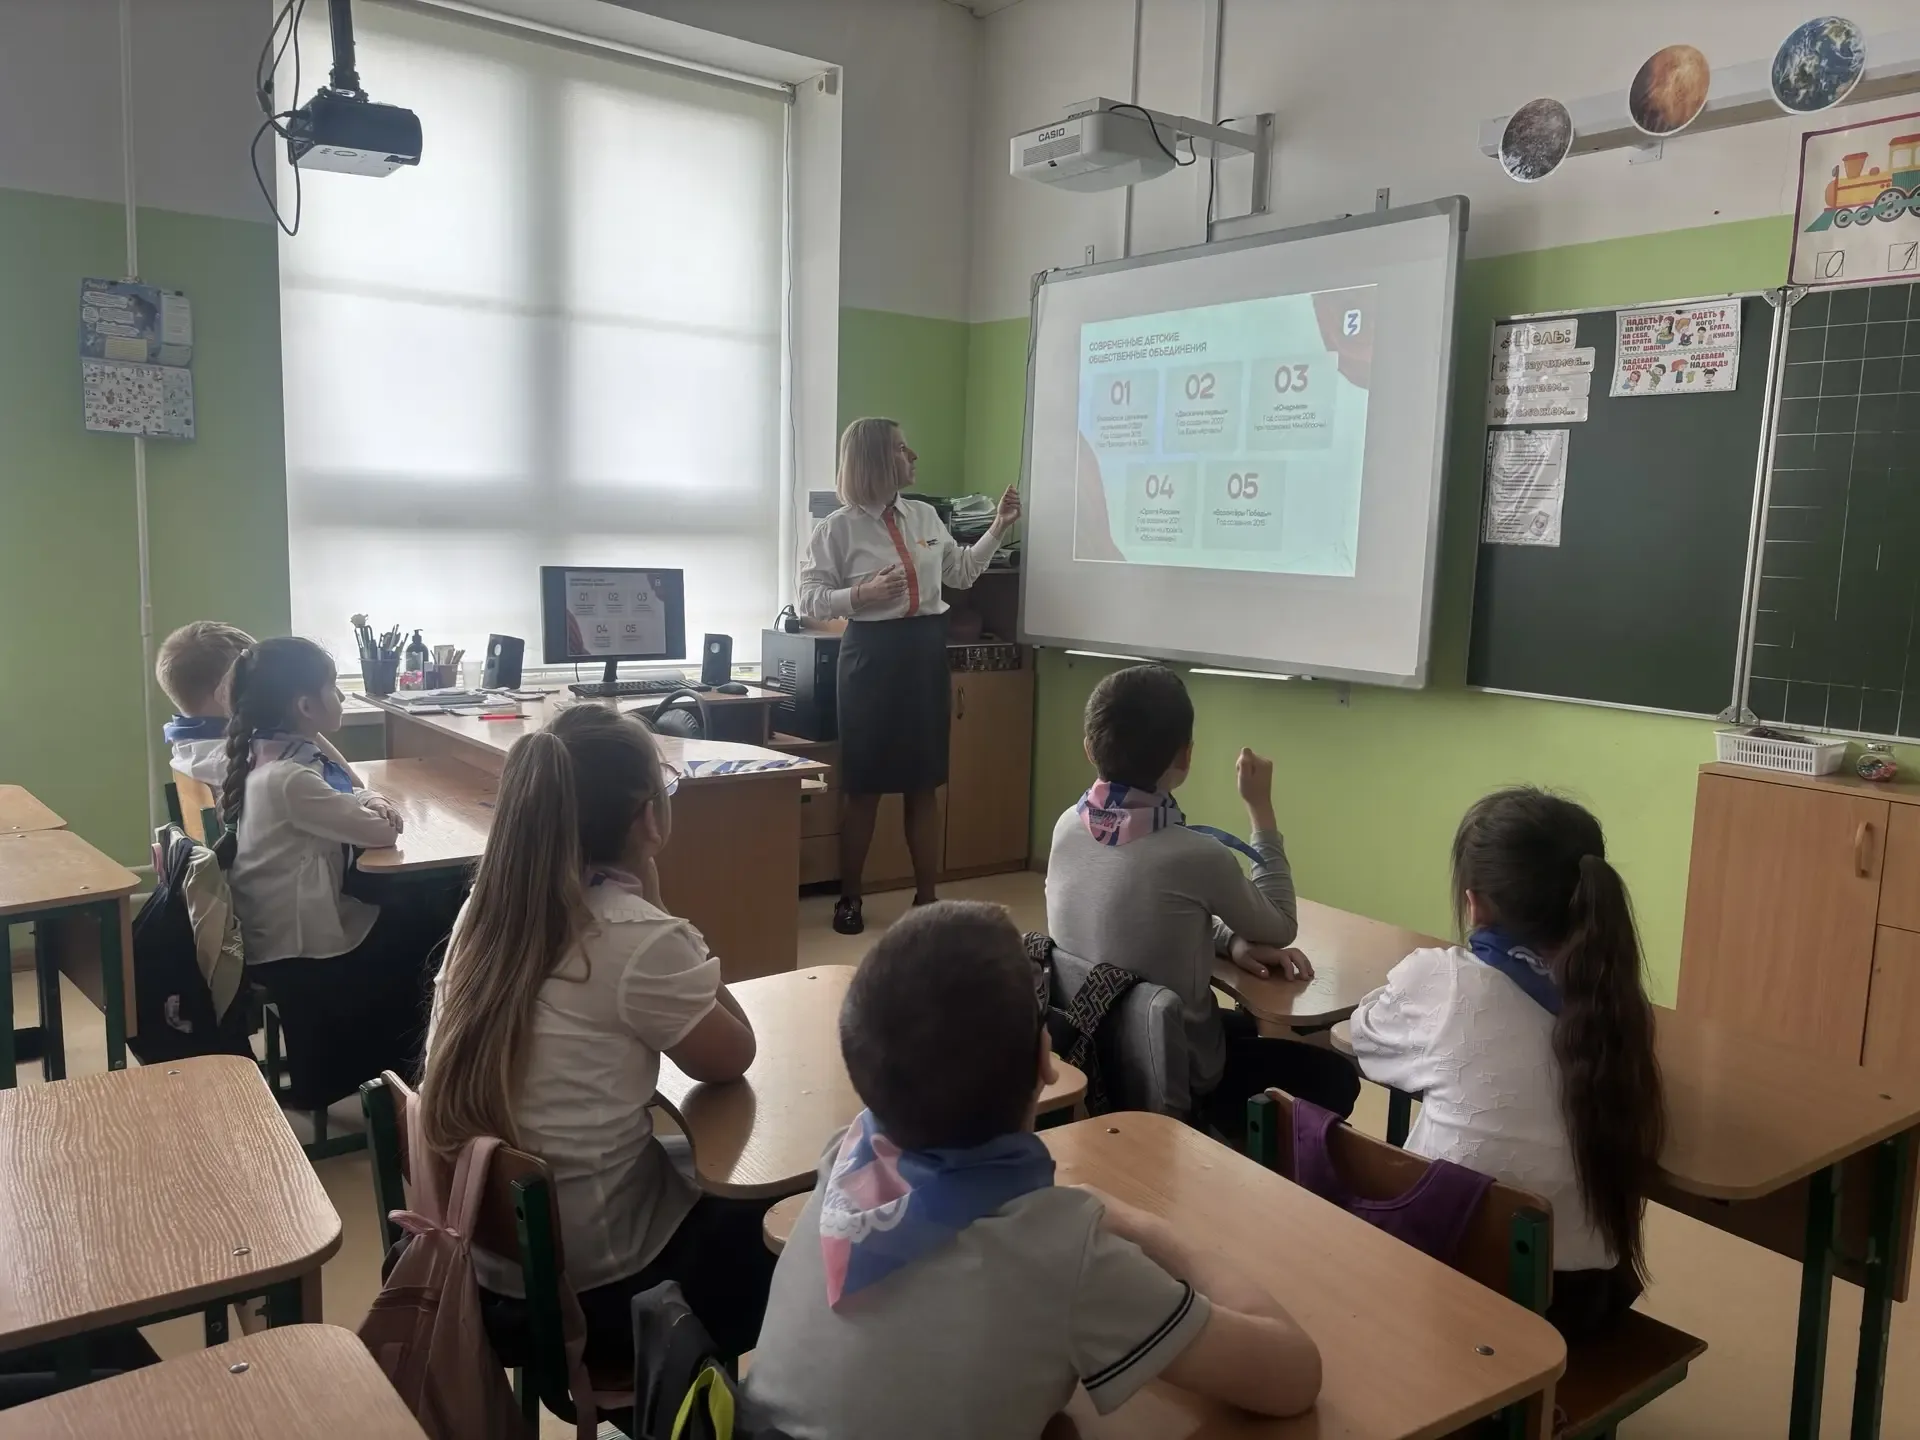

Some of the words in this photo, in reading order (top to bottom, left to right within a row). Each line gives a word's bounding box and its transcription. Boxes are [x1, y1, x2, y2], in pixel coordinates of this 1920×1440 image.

[1038, 127, 1065, 142] CASIO
[1825, 250, 1845, 278] 0
[1088, 349, 1147, 364] ОБЩЕСТВЕННЫЕ
[1149, 341, 1207, 358] ОБЪЕДИНЕНИЯ
[1089, 336, 1143, 352] СОВРЕМЕННЫЕ
[1144, 332, 1180, 346] ДЕТСКИЕ
[1690, 360, 1729, 368] НАДЕЖДУ
[1691, 352, 1725, 361] ОДЕВАЕМ
[1185, 372, 1216, 400] 02
[1274, 364, 1309, 394] 03
[1110, 380, 1131, 405] 01
[1145, 474, 1175, 499] 04
[1227, 473, 1259, 499] 05
[596, 624, 608, 634] 04
